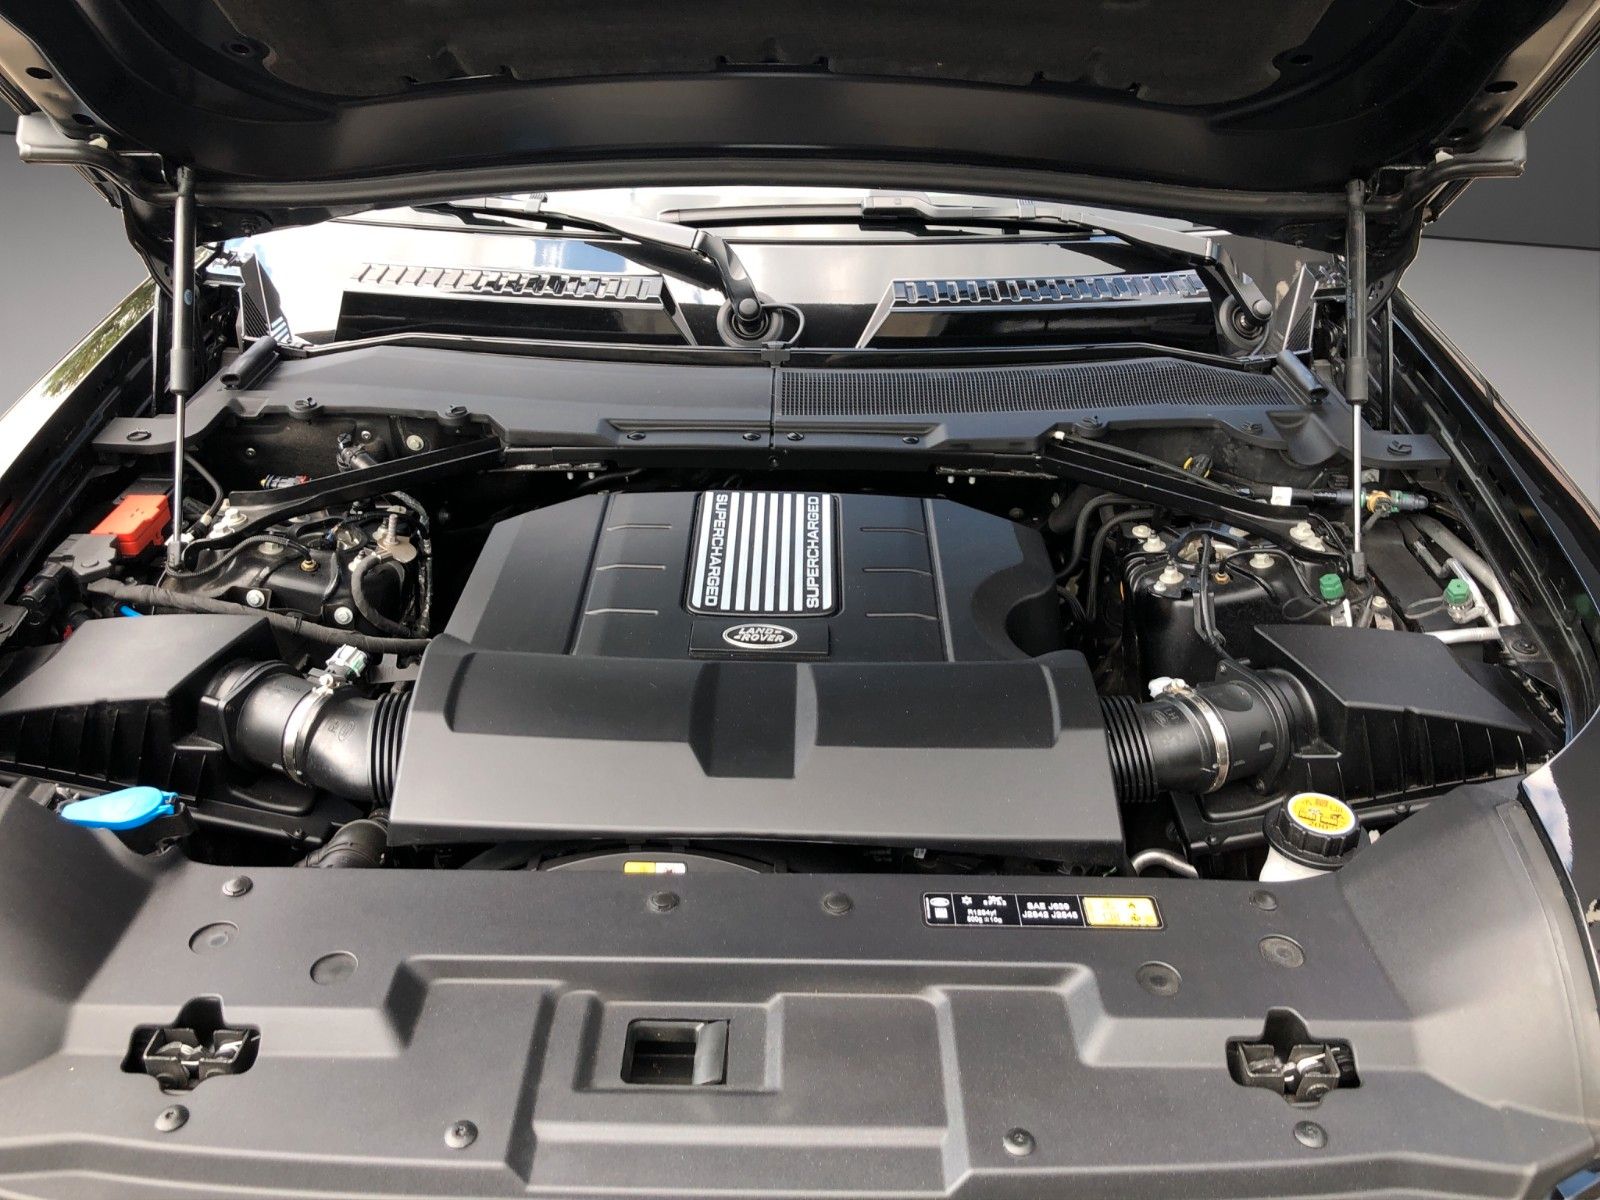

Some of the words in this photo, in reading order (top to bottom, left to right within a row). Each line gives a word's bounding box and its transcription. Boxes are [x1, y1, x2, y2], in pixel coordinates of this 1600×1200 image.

[705, 493, 728, 606] SUPERCHARGED
[806, 496, 819, 608] SUPERCHARGED
[738, 627, 774, 635] LAND
[740, 633, 785, 643] ROVER
